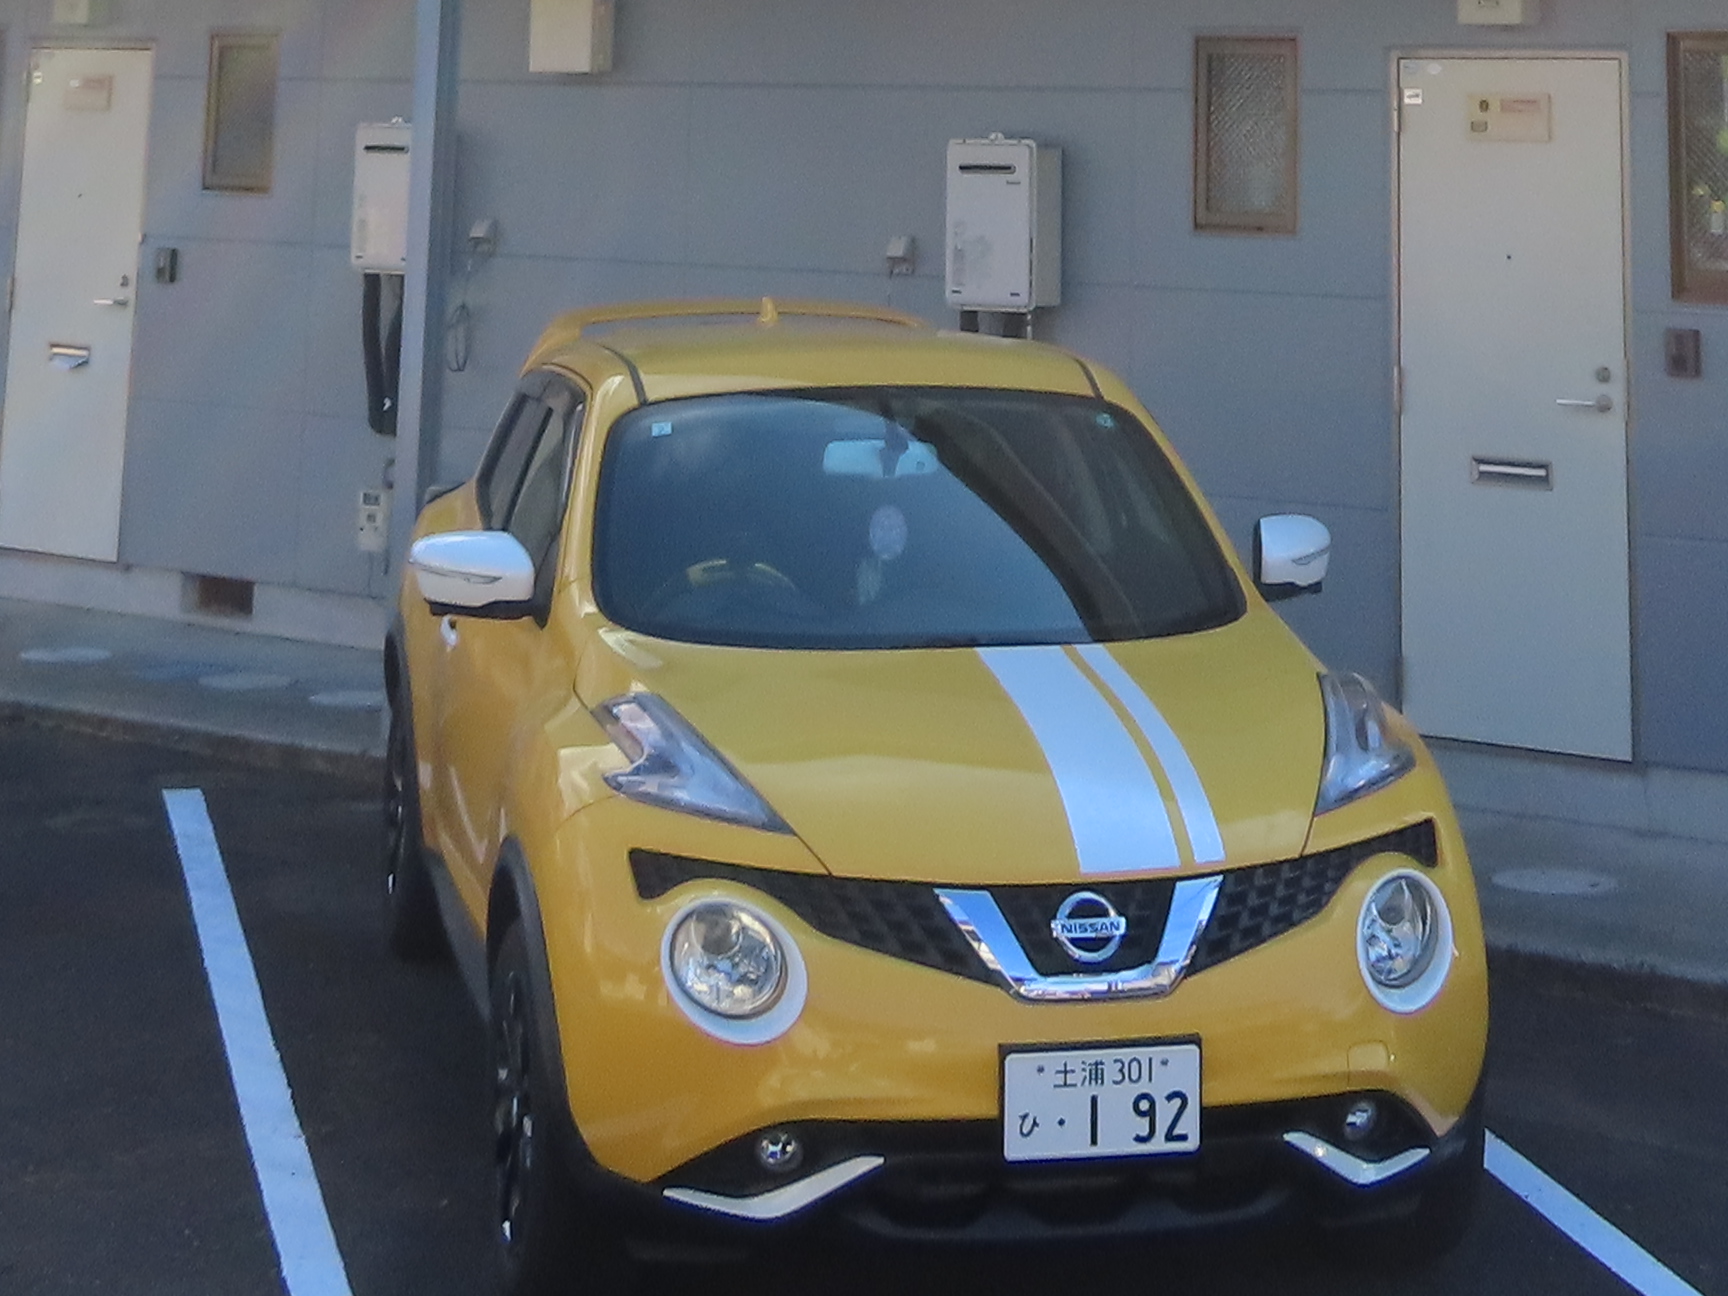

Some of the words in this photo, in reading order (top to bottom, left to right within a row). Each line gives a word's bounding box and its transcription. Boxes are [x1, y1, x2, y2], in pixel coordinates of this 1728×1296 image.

[1060, 919, 1121, 934] NISSAN
[1053, 1061, 1105, 1089] 土浦
[1112, 1056, 1153, 1086] 301
